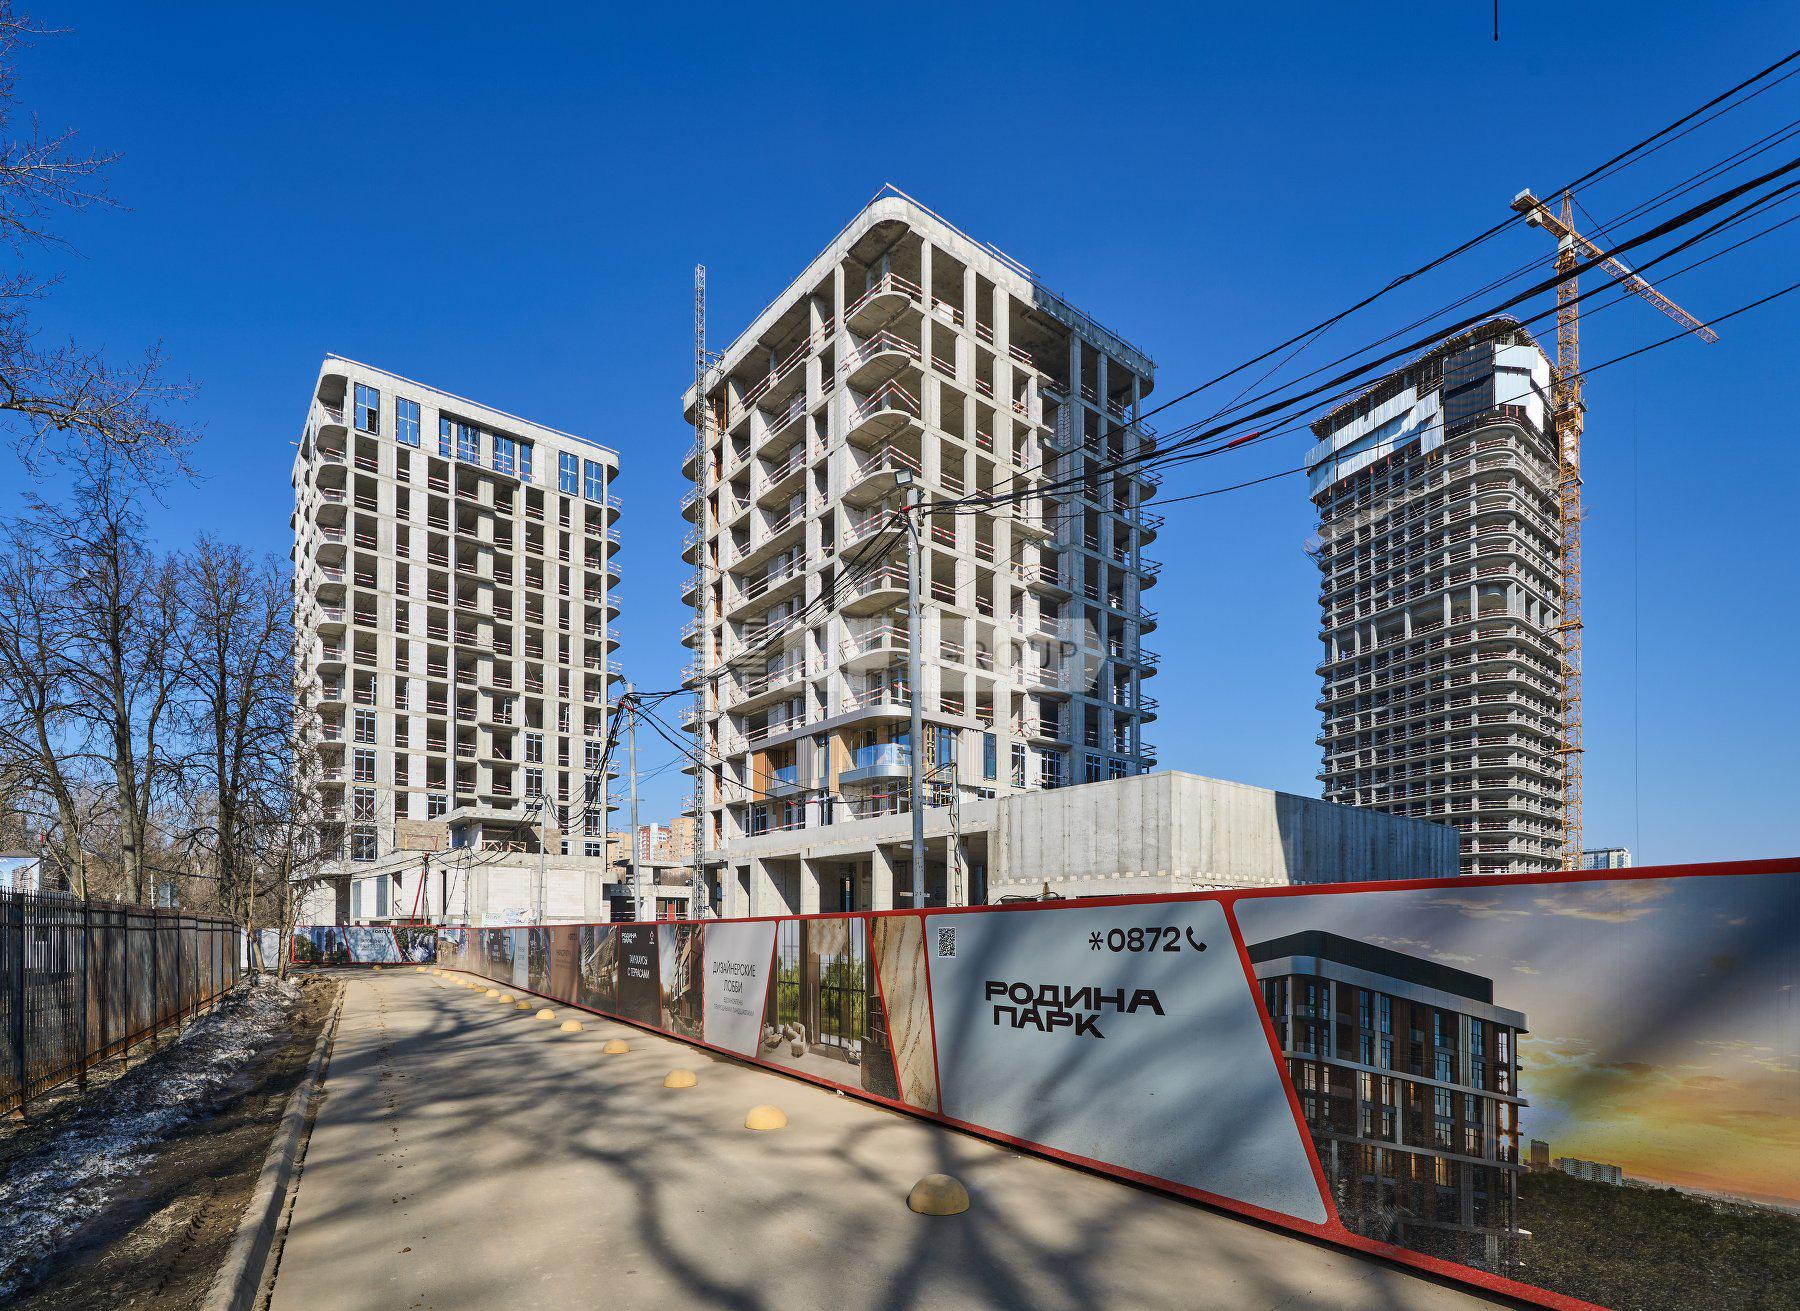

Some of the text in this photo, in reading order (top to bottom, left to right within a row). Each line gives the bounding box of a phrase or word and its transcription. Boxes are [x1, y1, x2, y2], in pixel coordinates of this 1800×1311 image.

[712, 960, 756, 978] ДИЗАЙНЕРСКИЕ
[723, 979, 743, 994] ЛОББИ
[985, 980, 1166, 1016] РОДИНА
[993, 1004, 1106, 1039] ПАРК
